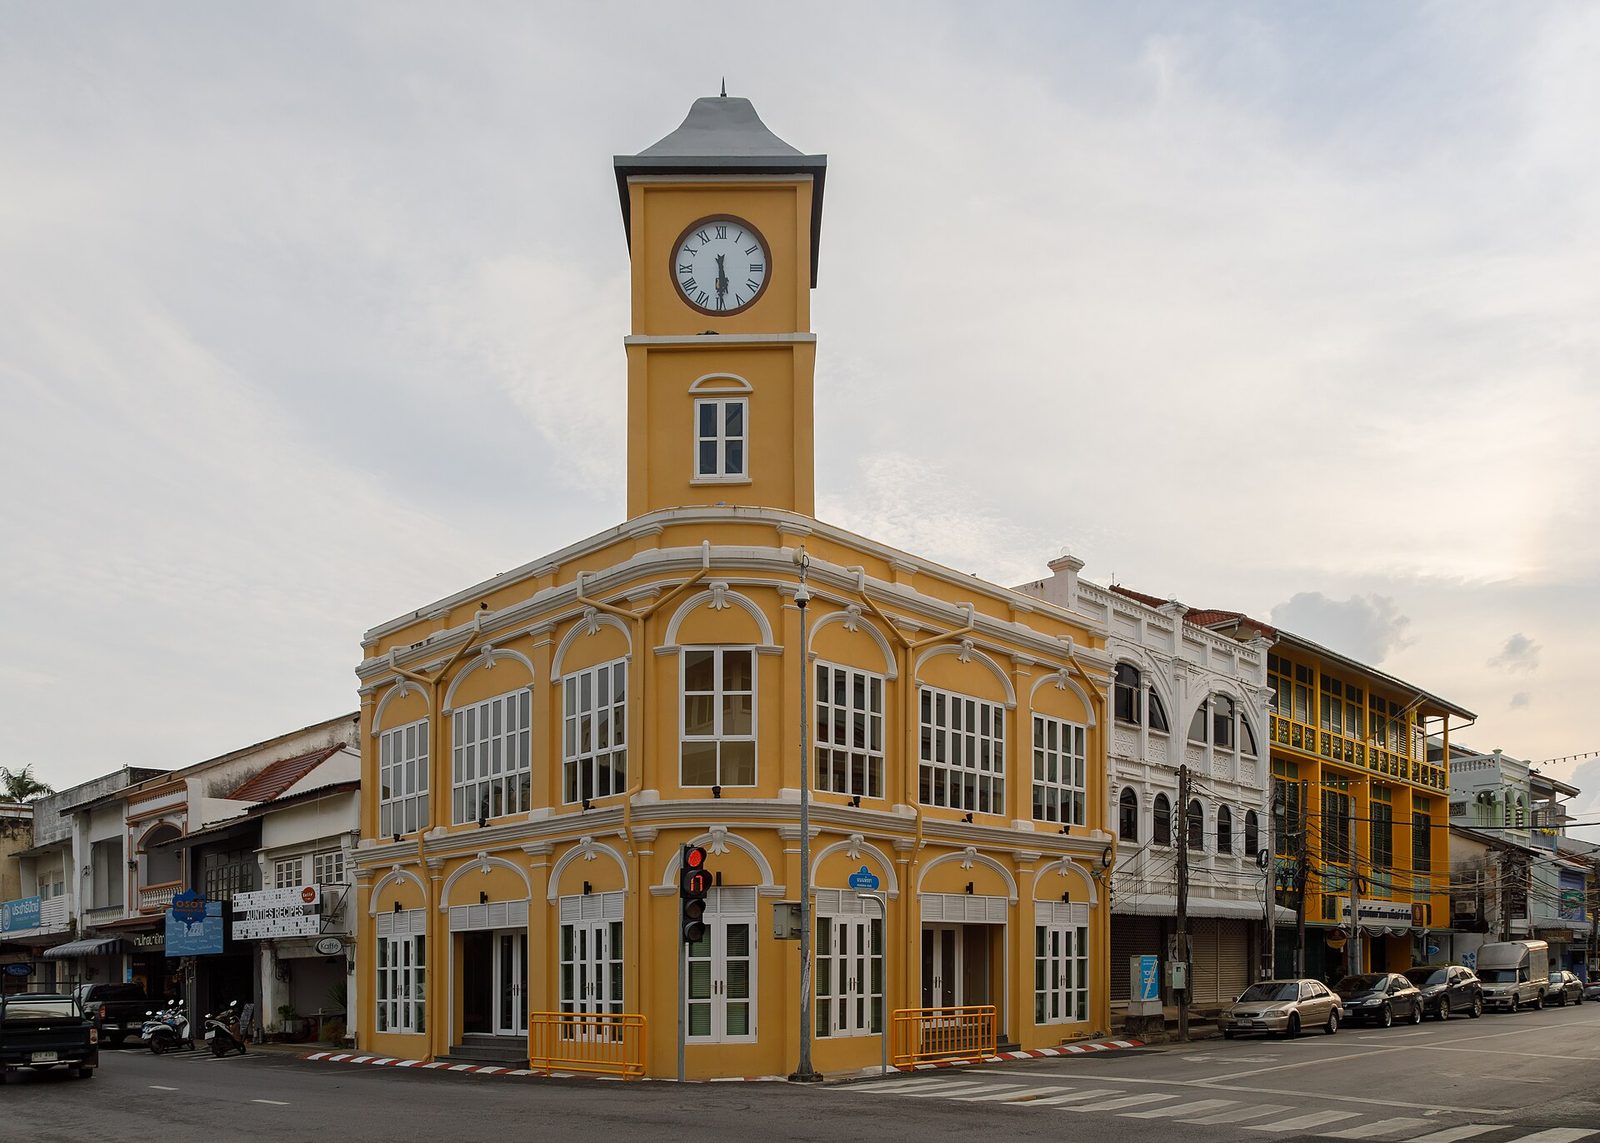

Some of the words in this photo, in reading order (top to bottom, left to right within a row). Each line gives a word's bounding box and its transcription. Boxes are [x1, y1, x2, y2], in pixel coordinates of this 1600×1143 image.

[697, 230, 711, 245] XI
[715, 226, 727, 239] XII
[735, 231, 743, 243] I
[683, 245, 698, 257] X
[745, 245, 758, 256] II
[680, 264, 692, 273] IX
[750, 264, 763, 272] III
[682, 277, 698, 295] VIII
[746, 278, 760, 293] IV
[696, 291, 709, 308] VII
[735, 293, 745, 306] V
[245, 907, 274, 921] AUNTIES
[274, 904, 304, 919] RECIPES
